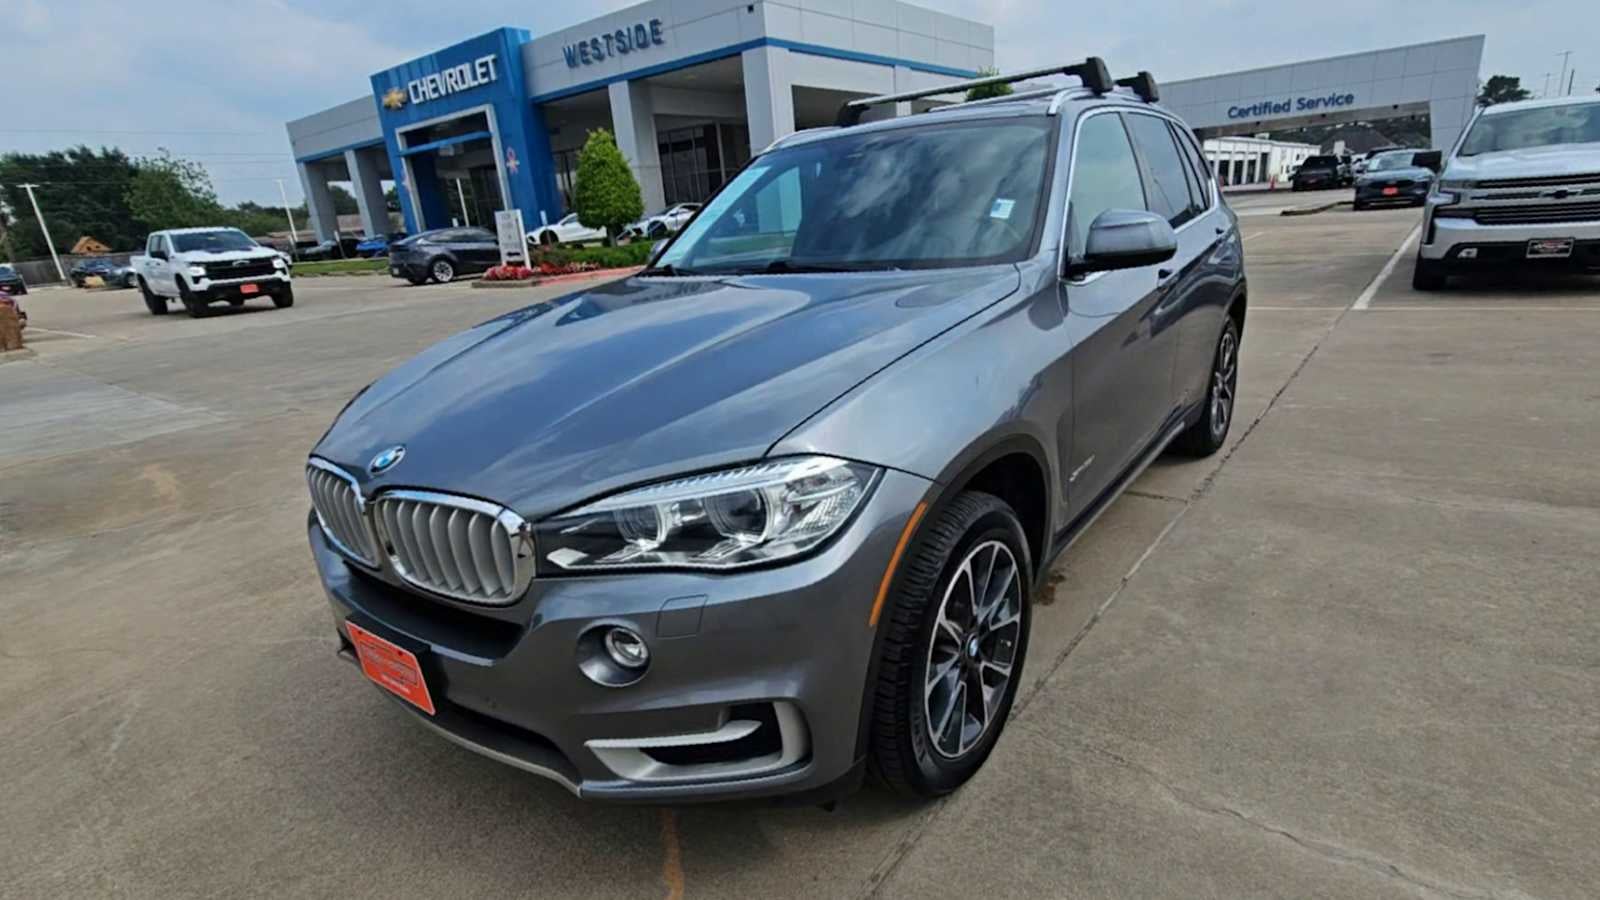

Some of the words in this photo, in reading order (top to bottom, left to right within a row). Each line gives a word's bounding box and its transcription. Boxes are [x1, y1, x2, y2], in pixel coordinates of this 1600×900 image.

[563, 19, 664, 68] WESTSIDE
[408, 54, 498, 105] CHEVROLET
[1228, 99, 1291, 118] Certified
[1296, 93, 1354, 110] Service
